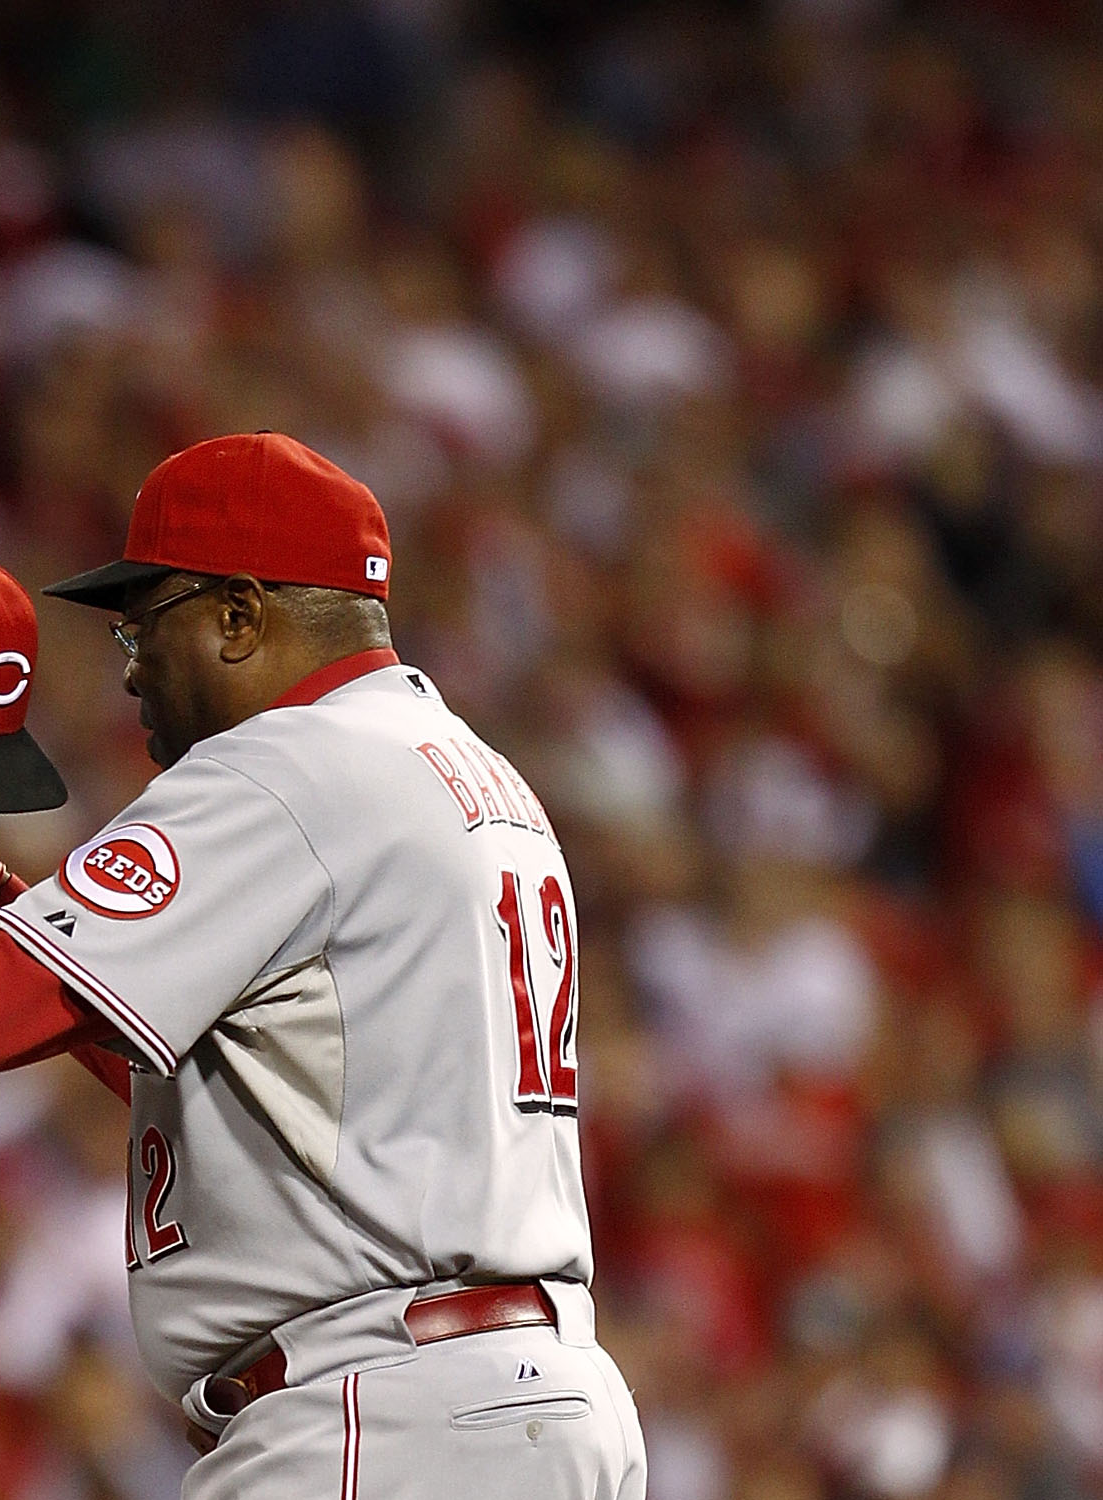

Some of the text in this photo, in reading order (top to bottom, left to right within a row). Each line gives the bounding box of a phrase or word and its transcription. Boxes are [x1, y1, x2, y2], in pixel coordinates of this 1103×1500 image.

[411, 735, 561, 849] BAKE
[84, 846, 172, 905] REDS
[491, 866, 579, 1117] 12
